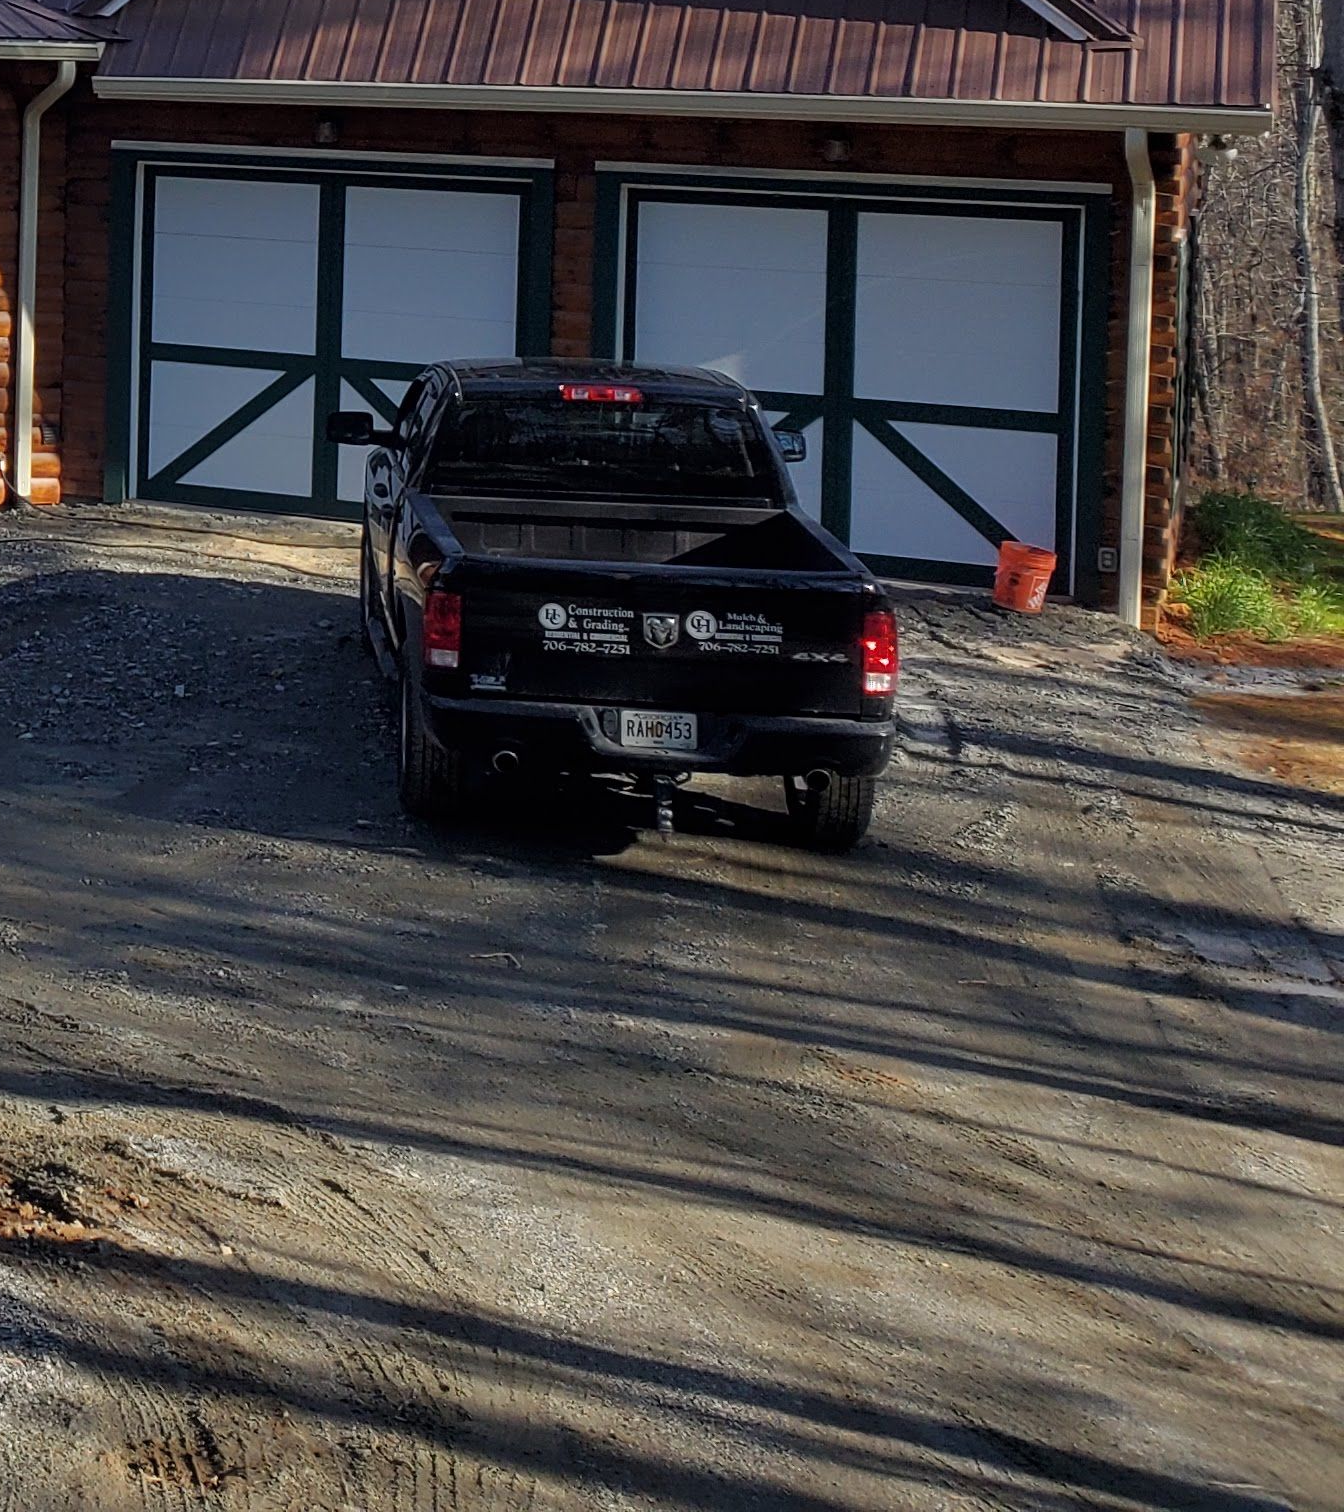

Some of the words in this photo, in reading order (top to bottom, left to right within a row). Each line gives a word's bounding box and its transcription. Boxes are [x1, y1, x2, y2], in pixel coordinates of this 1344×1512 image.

[568, 604, 634, 618] Construction
[727, 612, 756, 622] Mulch
[757, 614, 767, 624] &
[568, 618, 578, 628] &
[583, 618, 625, 633] Grading
[719, 620, 783, 634] Landscaping
[542, 640, 631, 655] 706-782-7251
[698, 641, 780, 655] 706-782-7251
